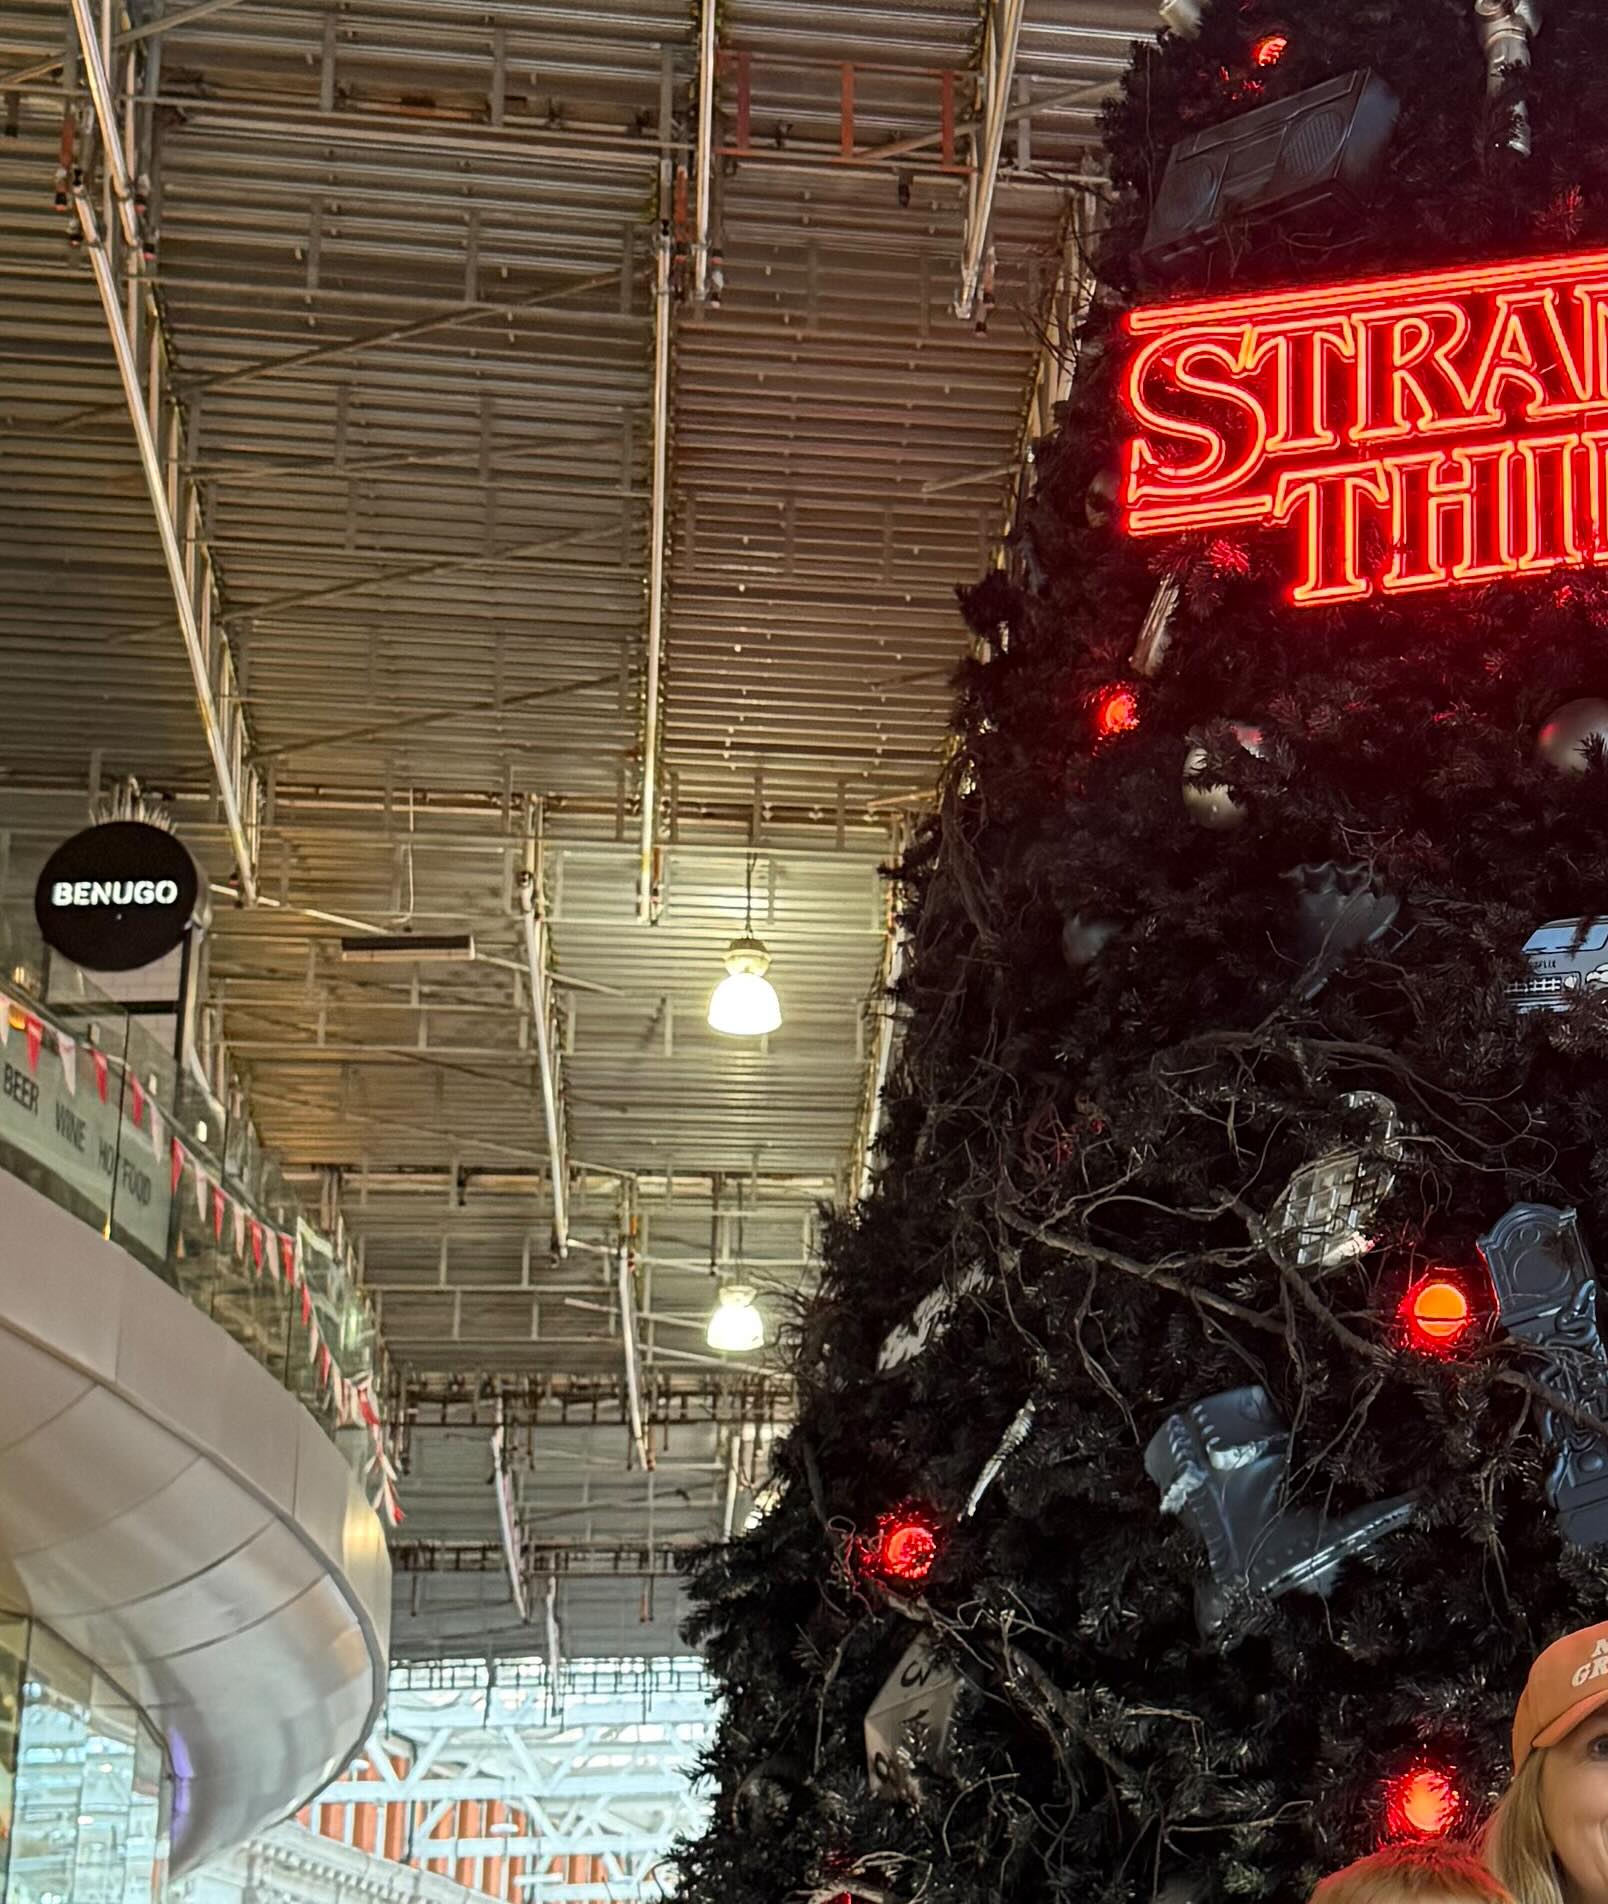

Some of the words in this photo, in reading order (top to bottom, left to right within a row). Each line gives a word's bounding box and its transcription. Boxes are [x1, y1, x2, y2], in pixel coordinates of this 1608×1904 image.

[51, 879, 178, 907] BENUGO
[3, 1060, 40, 1117] BEER
[55, 1099, 87, 1153] WINE
[99, 1137, 116, 1177] HO
[122, 1156, 152, 1207] FOOD
